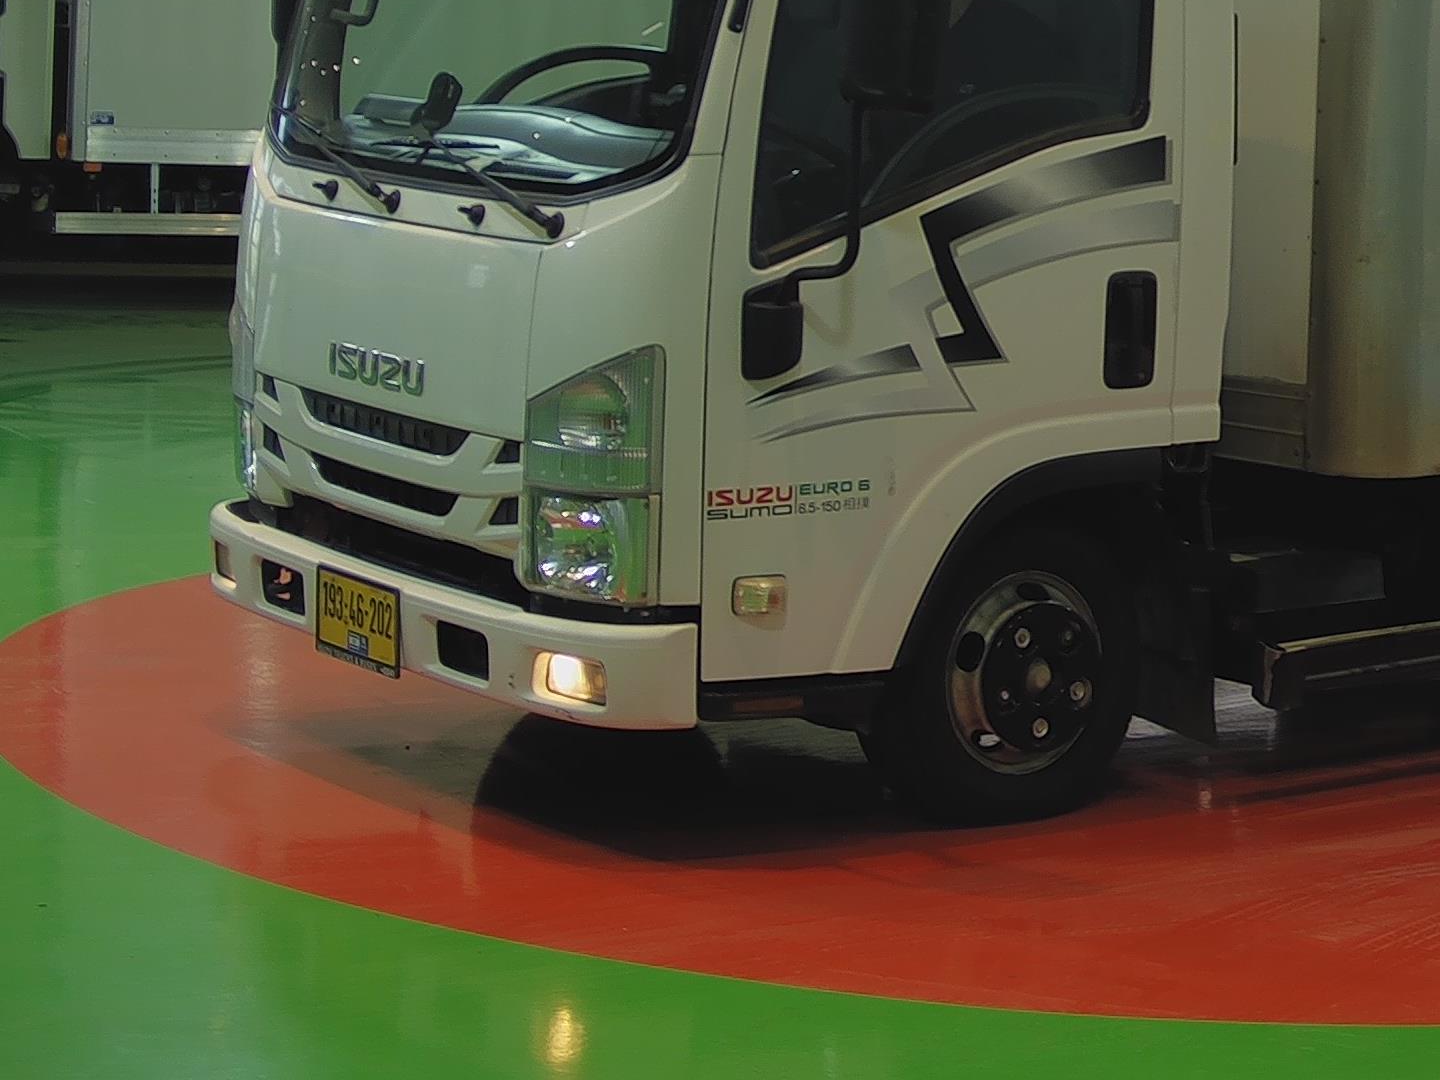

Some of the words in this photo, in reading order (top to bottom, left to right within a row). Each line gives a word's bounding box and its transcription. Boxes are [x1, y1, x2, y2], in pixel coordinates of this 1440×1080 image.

[329, 340, 425, 397] ISUZU
[707, 484, 793, 507] ISUZU
[799, 480, 853, 496] EURO
[858, 479, 871, 492] 6
[706, 504, 793, 521] SUMO
